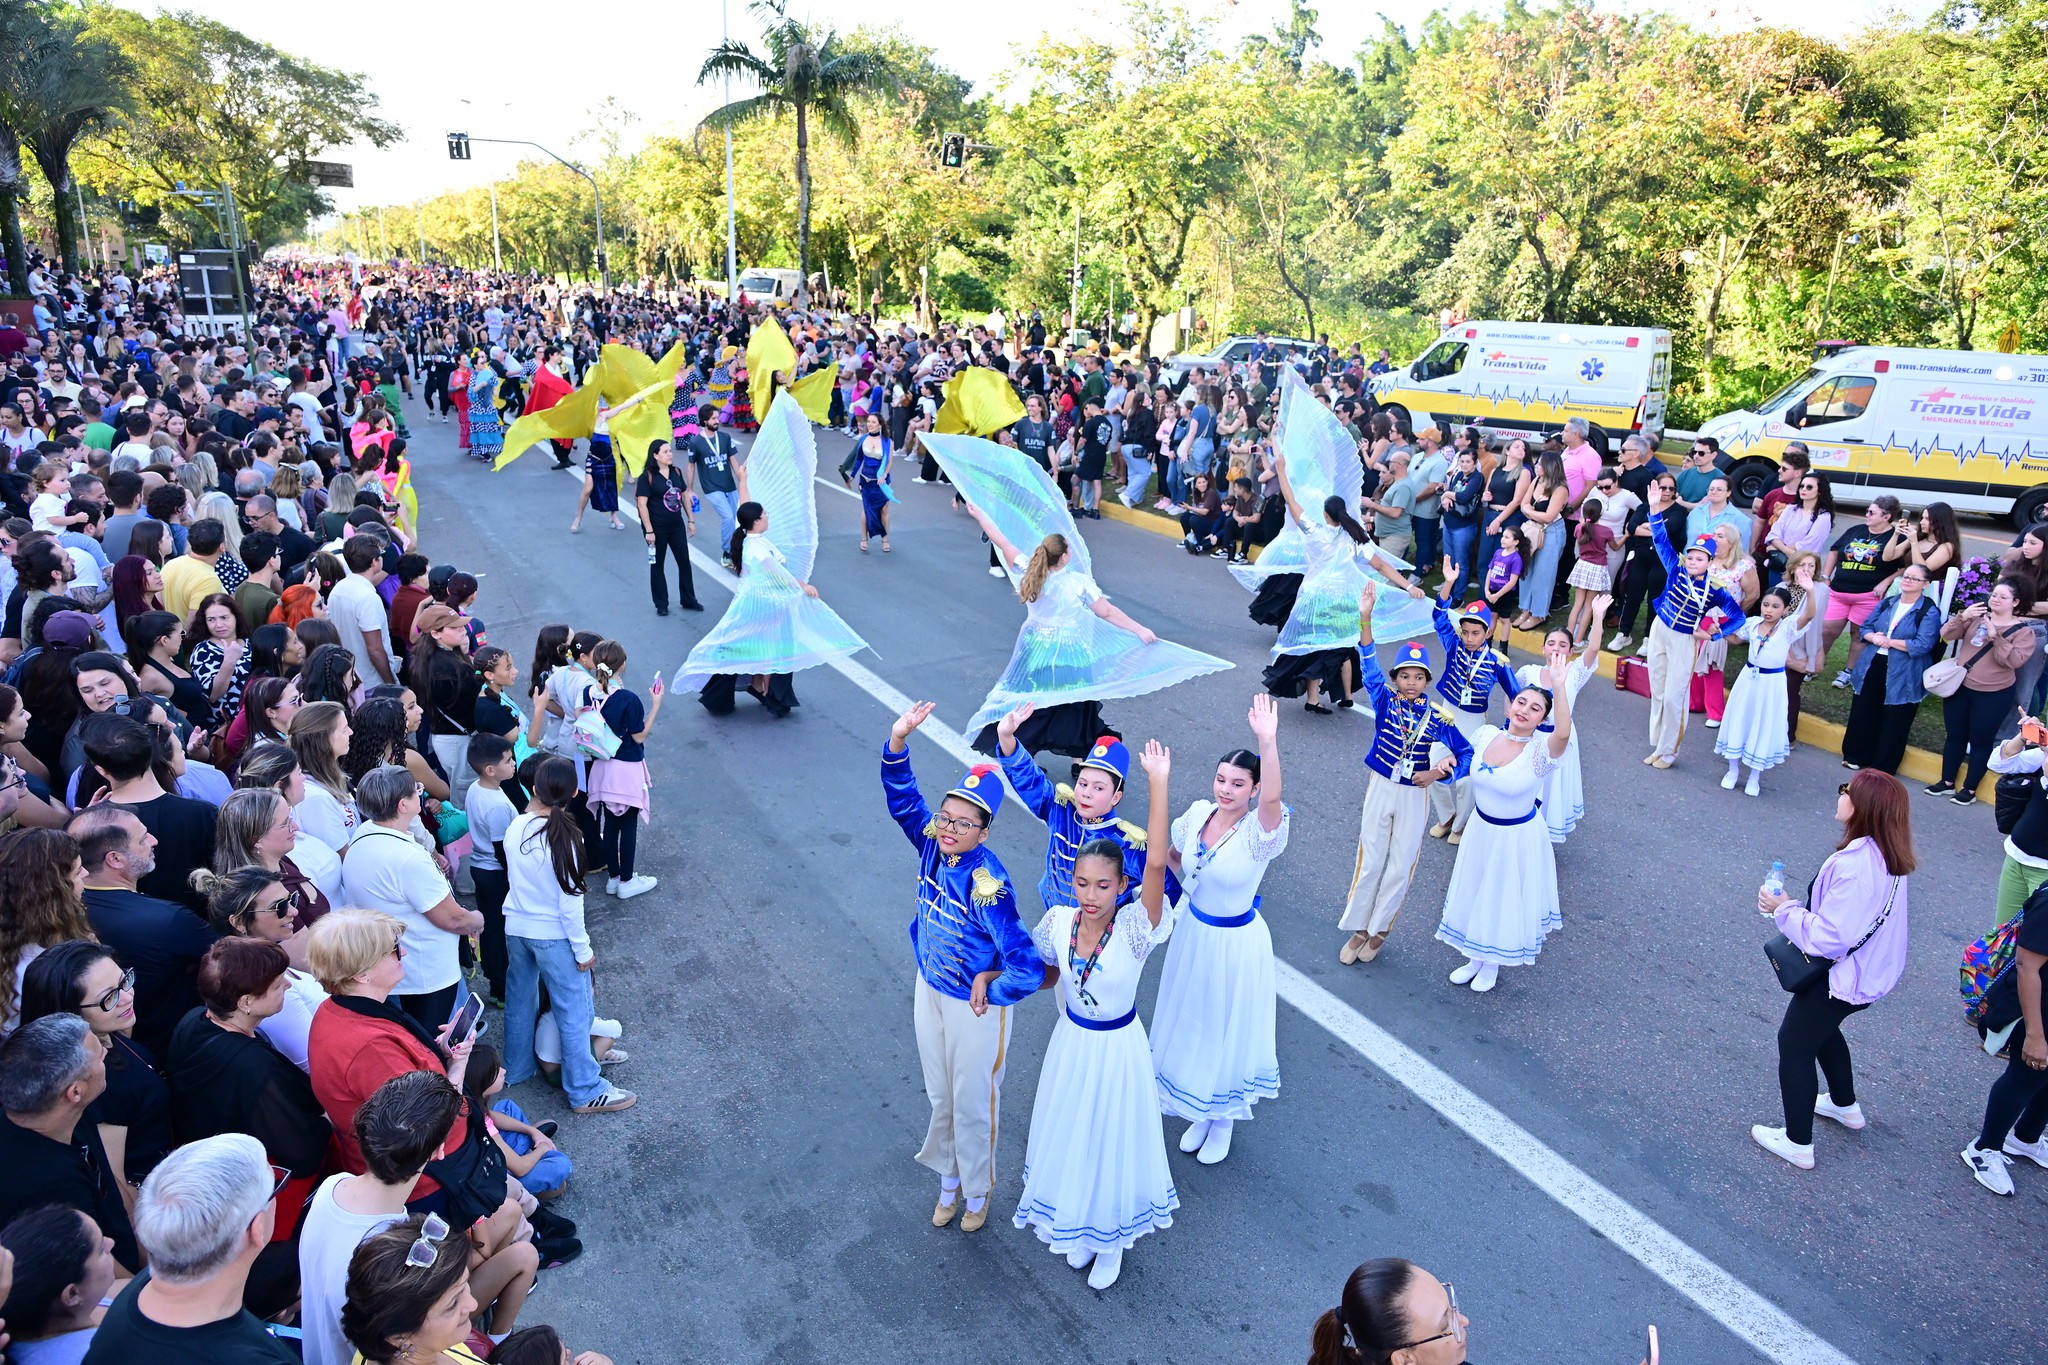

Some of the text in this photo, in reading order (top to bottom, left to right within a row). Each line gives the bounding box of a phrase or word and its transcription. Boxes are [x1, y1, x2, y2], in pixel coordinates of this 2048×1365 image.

[1486, 332, 1551, 341] www.transvidasc.com
[1482, 358, 1547, 371] TransVida
[1895, 363, 1992, 375] www.transvidasc.com
[1909, 399, 2032, 421] TransVida
